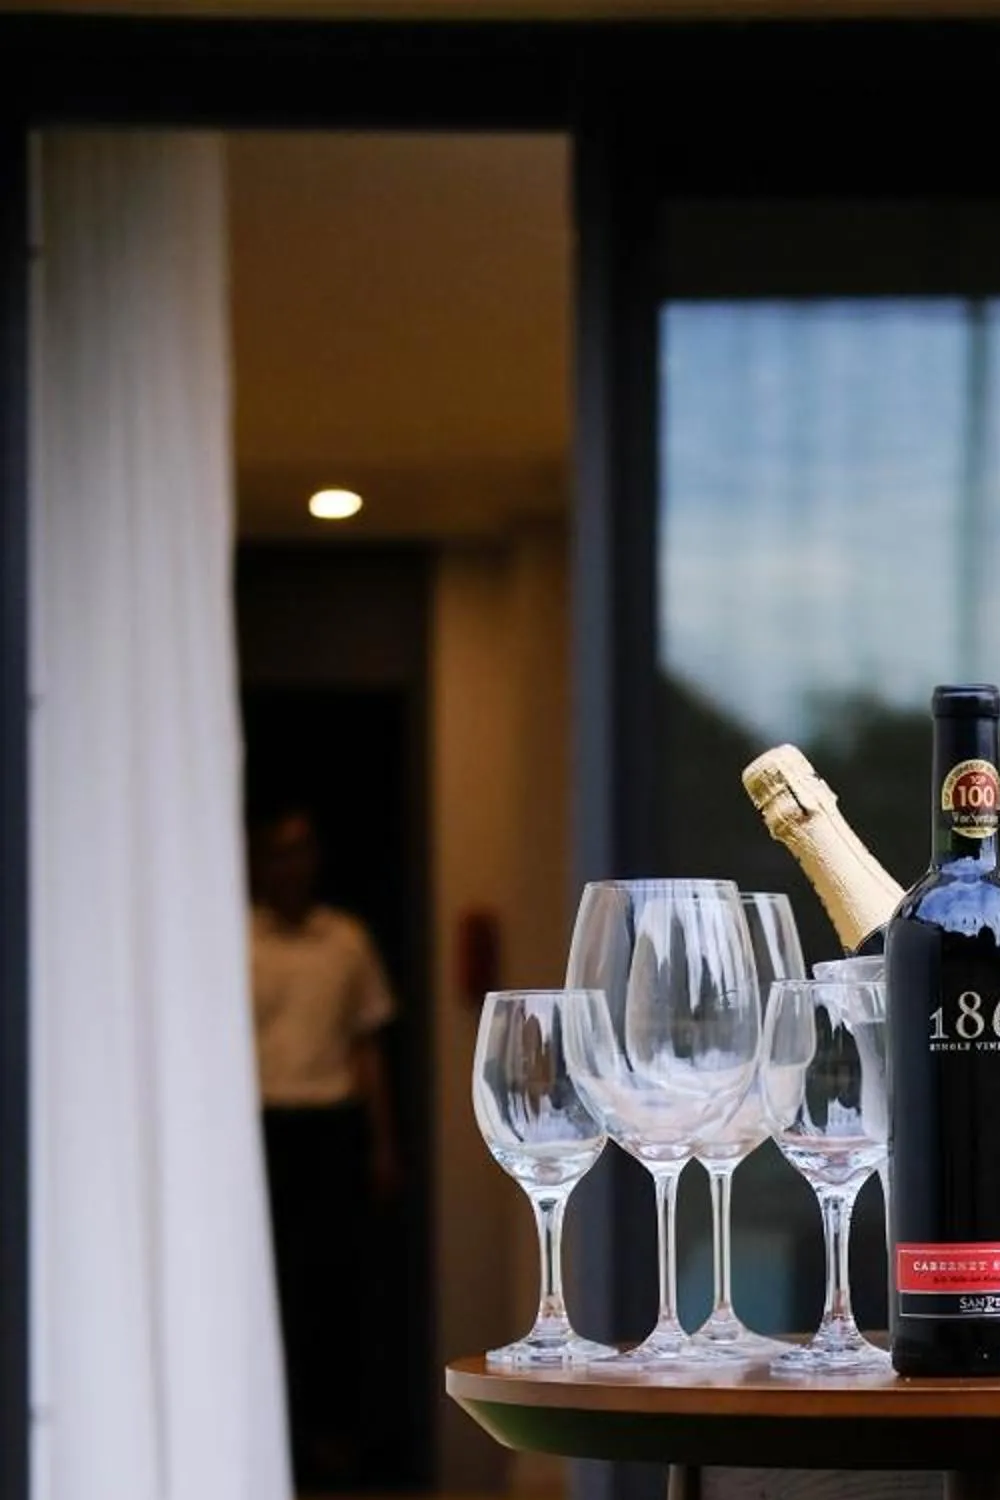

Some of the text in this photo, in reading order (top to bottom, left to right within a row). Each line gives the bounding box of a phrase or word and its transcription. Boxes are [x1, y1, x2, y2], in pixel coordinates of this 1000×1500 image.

[958, 785, 994, 807] 100
[929, 1042, 971, 1051] SINGLE
[913, 1261, 988, 1271] CABERNET
